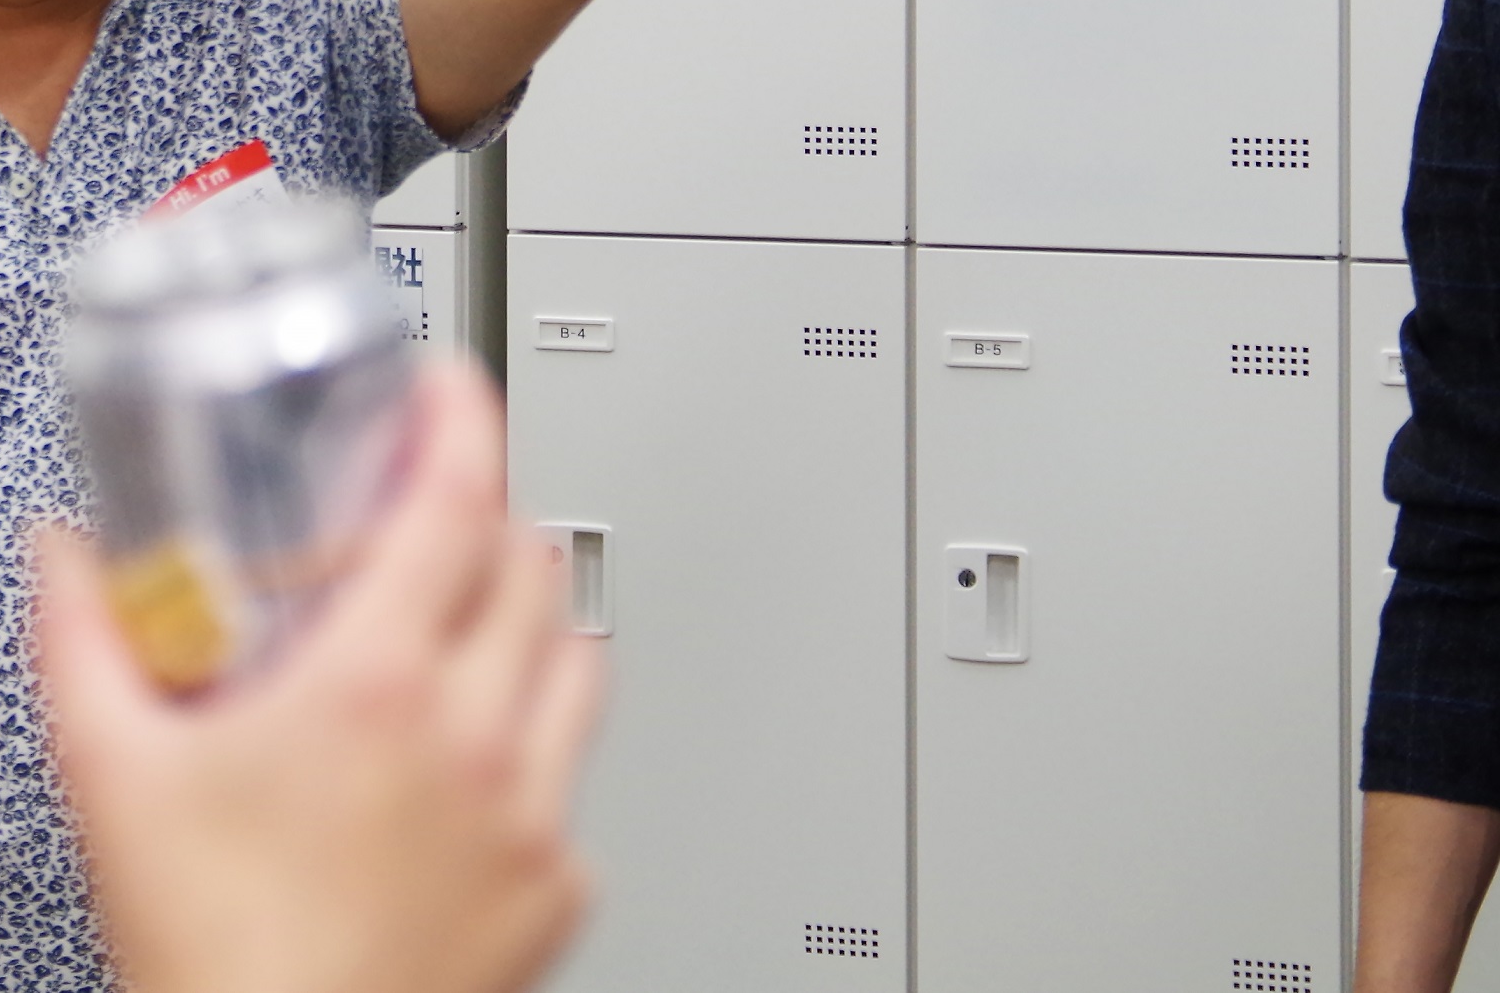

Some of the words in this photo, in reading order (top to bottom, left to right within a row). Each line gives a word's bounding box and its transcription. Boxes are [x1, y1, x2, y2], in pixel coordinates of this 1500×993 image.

[196, 168, 231, 192] I'm
[560, 327, 586, 339] B-4
[974, 343, 1002, 356] B-5
